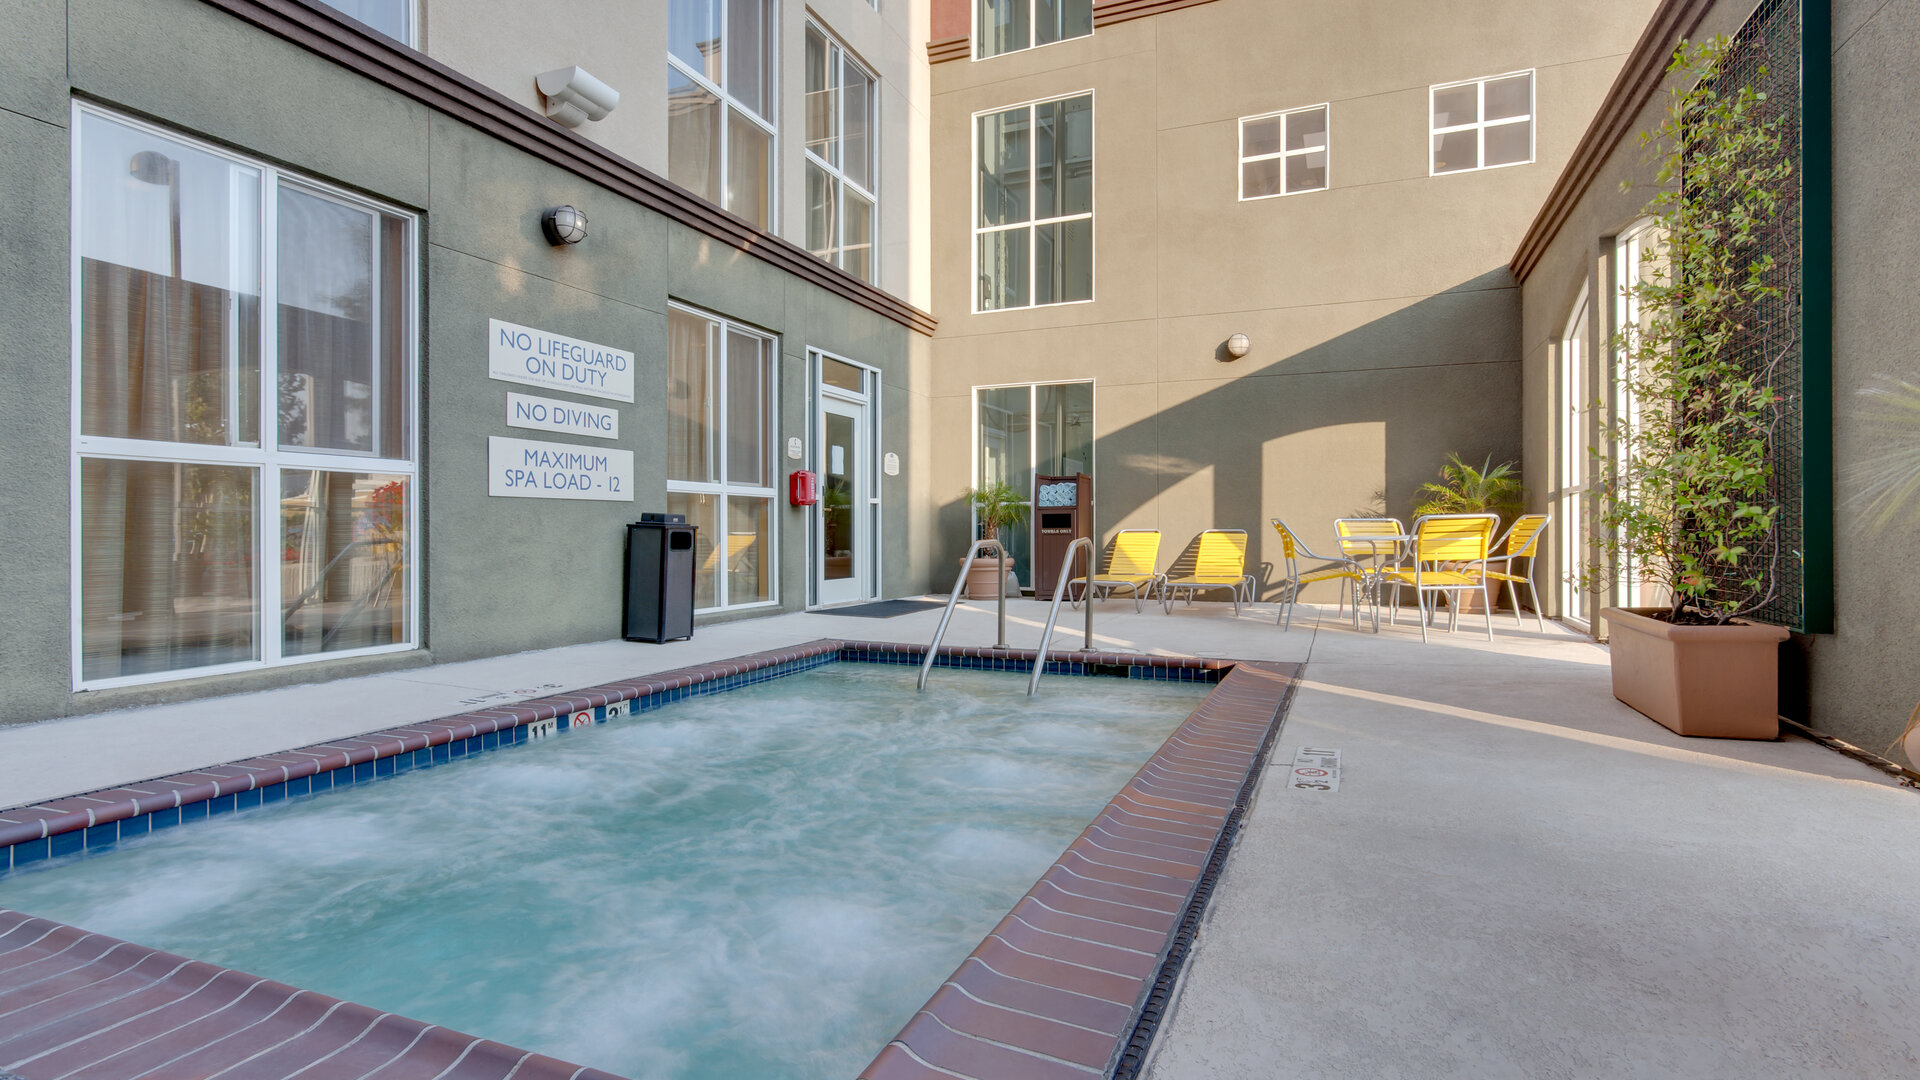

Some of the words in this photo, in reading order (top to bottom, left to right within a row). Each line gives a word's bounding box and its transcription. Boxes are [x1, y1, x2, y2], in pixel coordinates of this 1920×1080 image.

[500, 328, 532, 351] NO
[538, 337, 627, 372] LIFEGUARD
[526, 356, 556, 378] ON
[562, 363, 608, 387] DUTY
[516, 401, 547, 422] NO
[553, 407, 612, 431] DIVING
[524, 448, 607, 472] MAXIMUM
[505, 469, 538, 488] SPA
[544, 471, 592, 491] LOAD
[609, 476, 621, 492] 12
